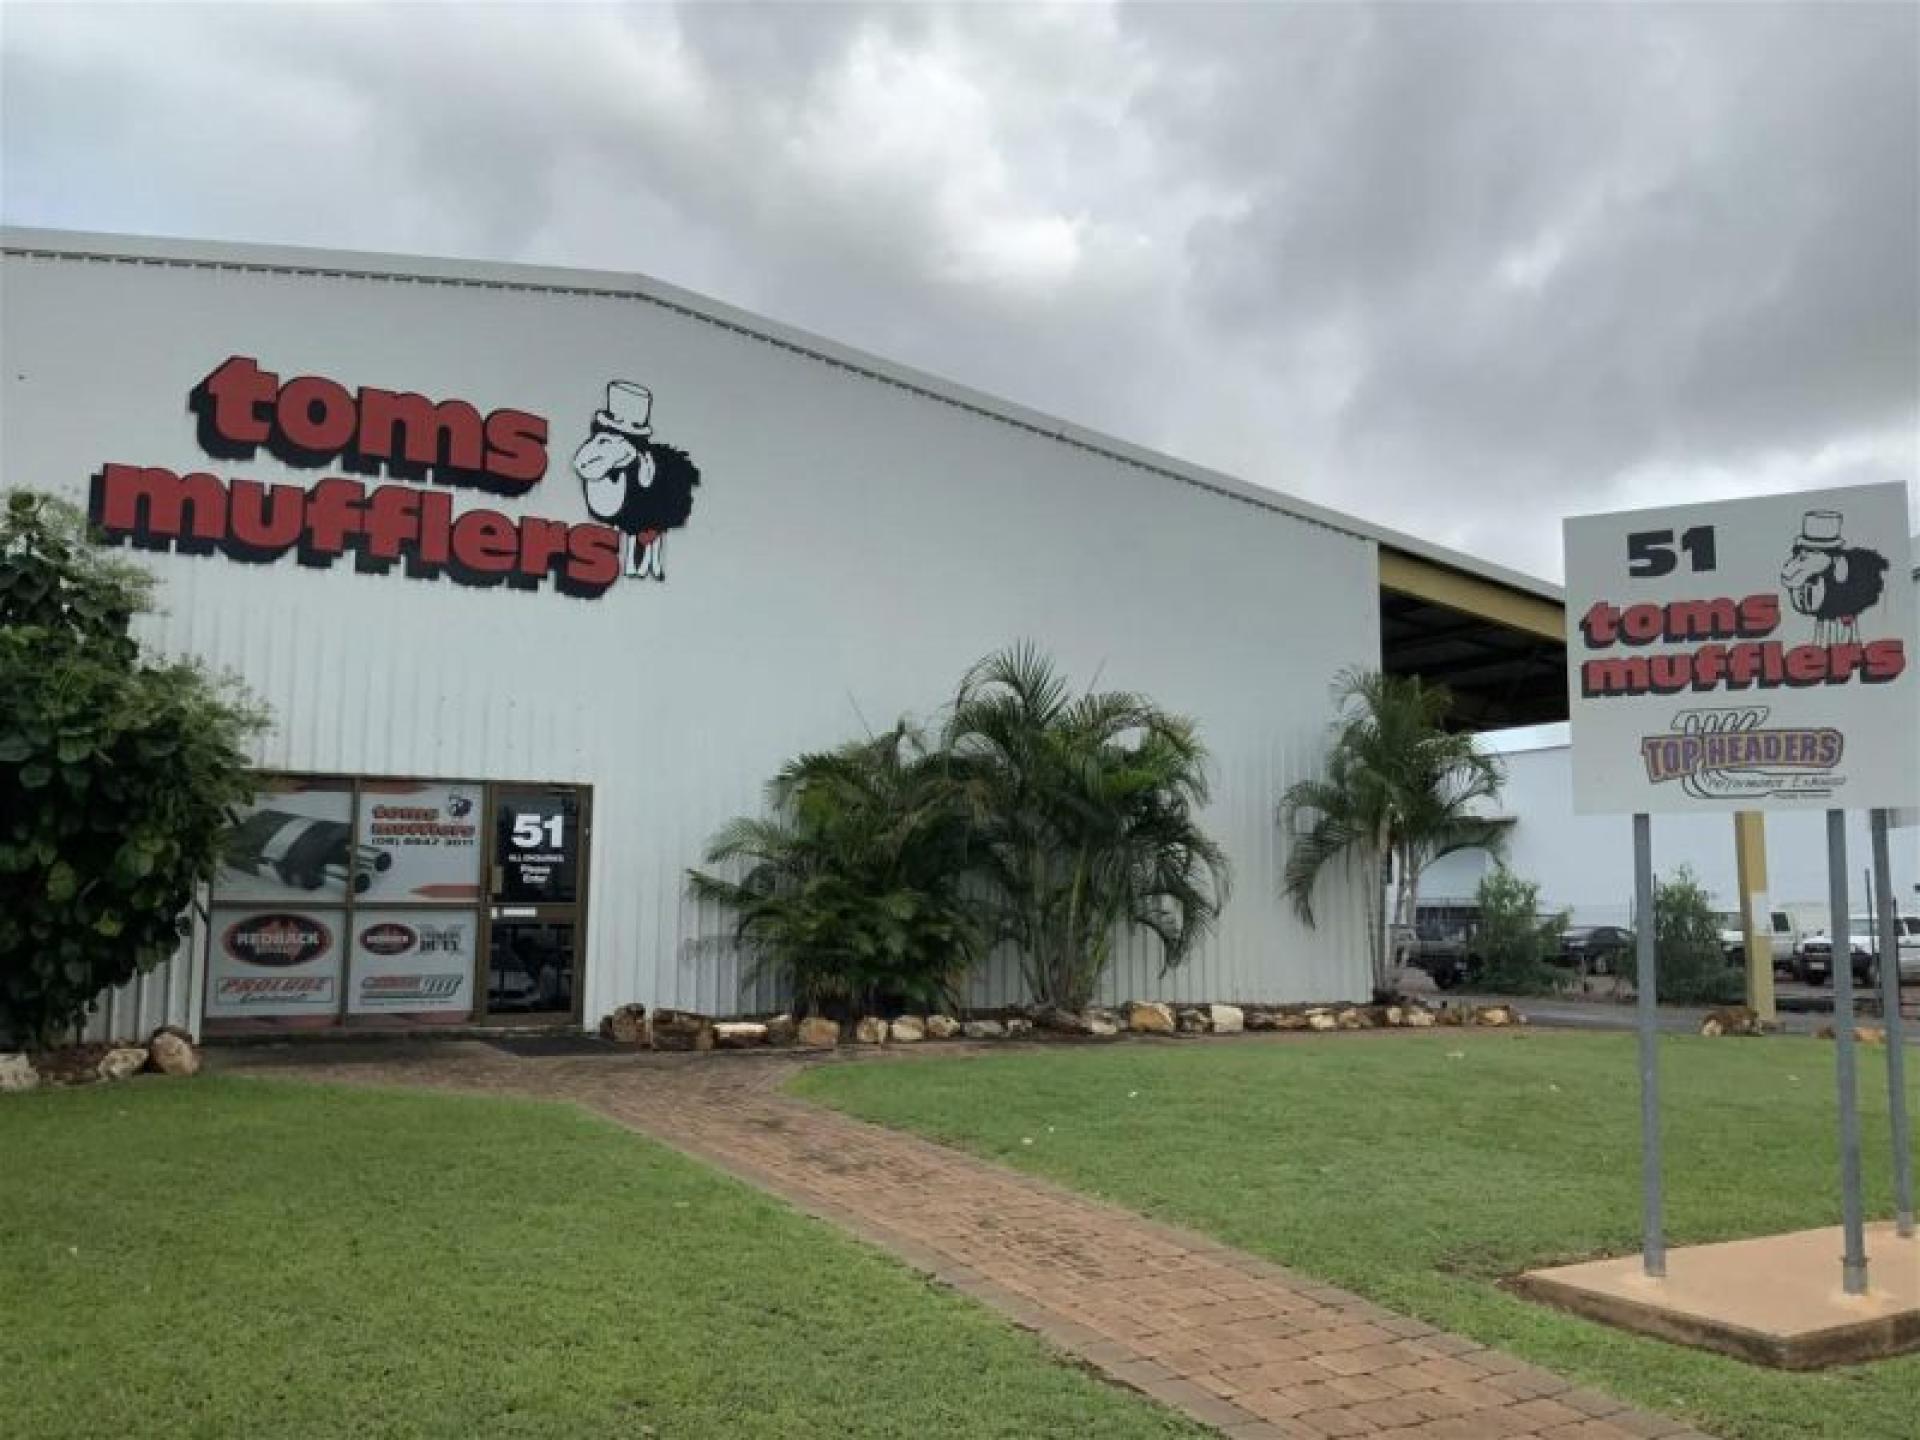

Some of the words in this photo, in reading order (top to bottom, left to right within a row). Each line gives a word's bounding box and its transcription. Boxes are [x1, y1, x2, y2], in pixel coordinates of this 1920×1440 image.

[190, 355, 547, 497] toms
[90, 463, 620, 599] mufflers
[1627, 525, 1717, 577] 51
[1580, 594, 1781, 649] toms
[1582, 639, 1906, 699] mufflers
[1648, 739, 1698, 777] TOP
[1707, 732, 1838, 769] HEADERS
[511, 813, 564, 848] 51
